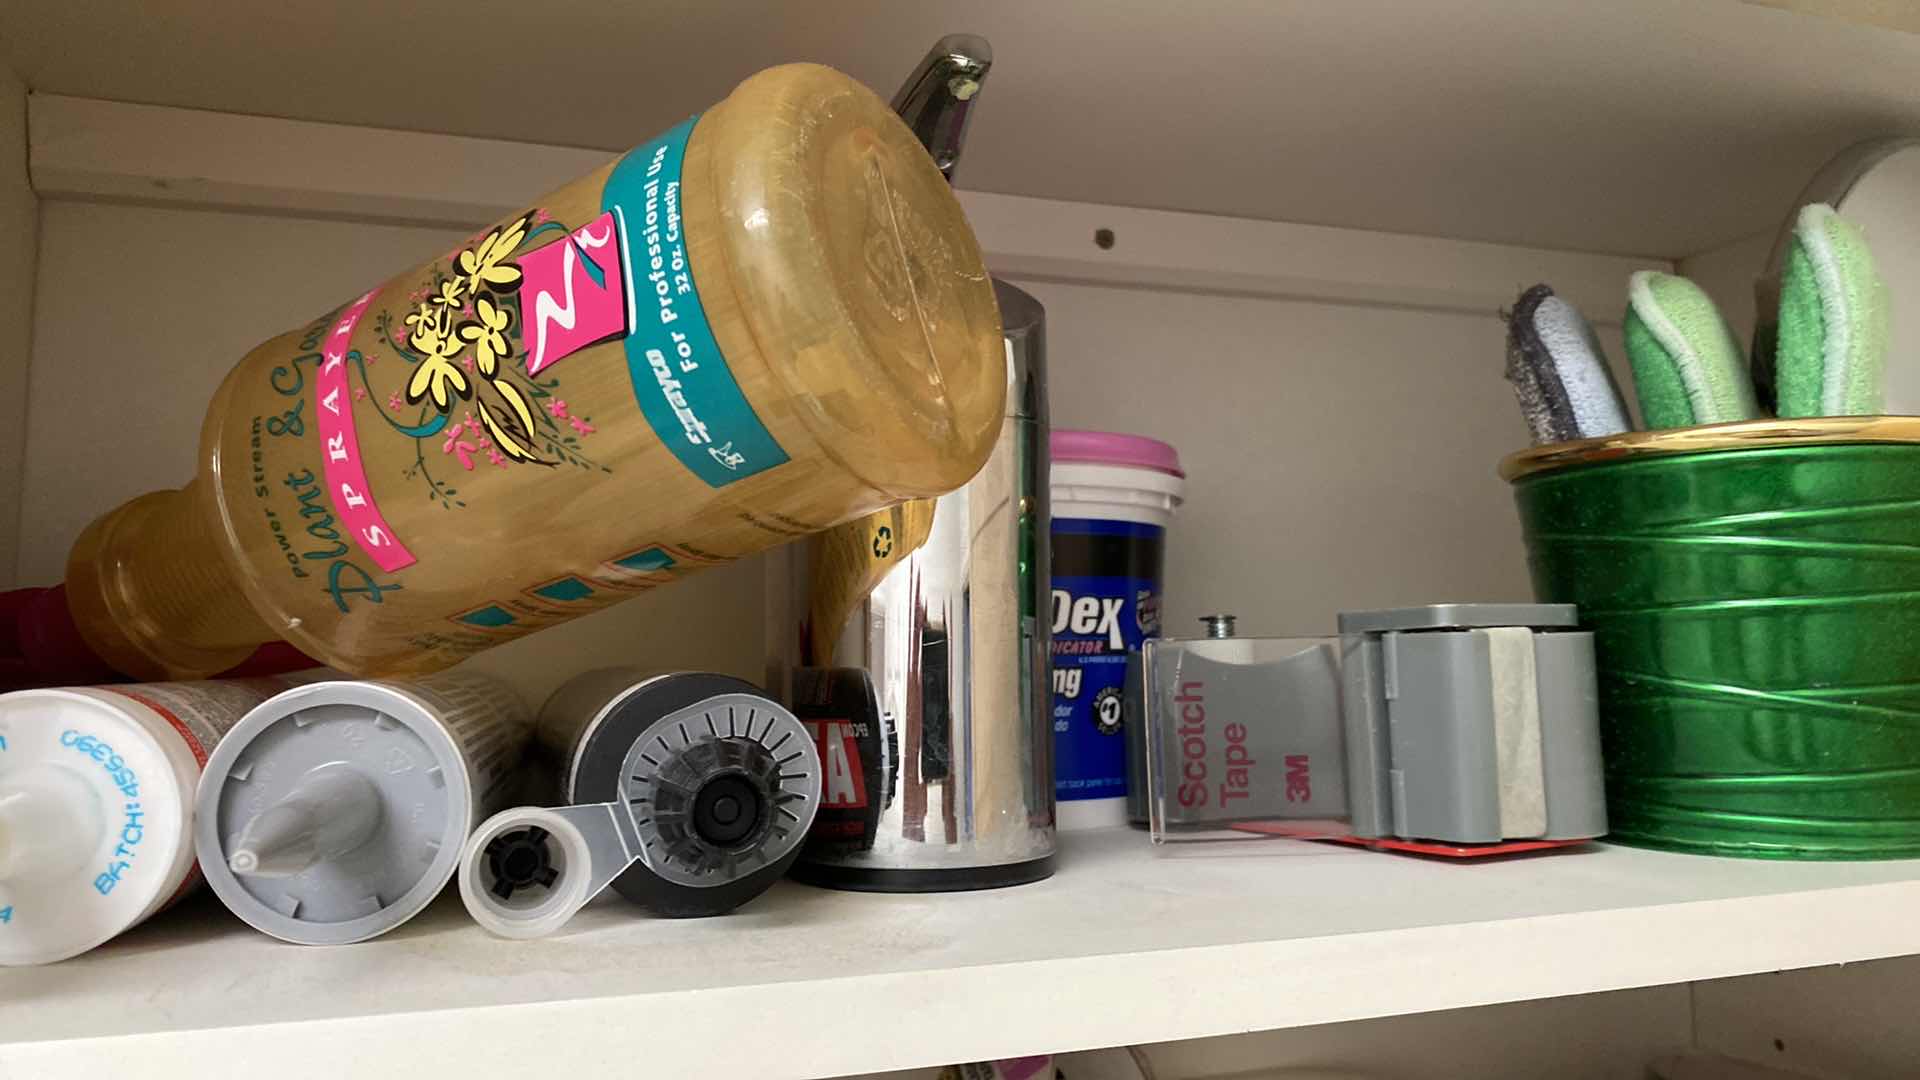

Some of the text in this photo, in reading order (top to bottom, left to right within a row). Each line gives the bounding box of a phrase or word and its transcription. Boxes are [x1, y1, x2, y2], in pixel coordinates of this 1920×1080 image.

[664, 181, 681, 243] Capacity
[643, 144, 698, 373] For Professional Use
[674, 275, 691, 295] 32
[266, 398, 305, 437] &
[251, 415, 309, 579] Power Stream
[283, 468, 403, 614] Plant
[1174, 682, 1208, 808] Scotch
[1219, 722, 1256, 809] Tape
[1284, 754, 1311, 803] 3M
